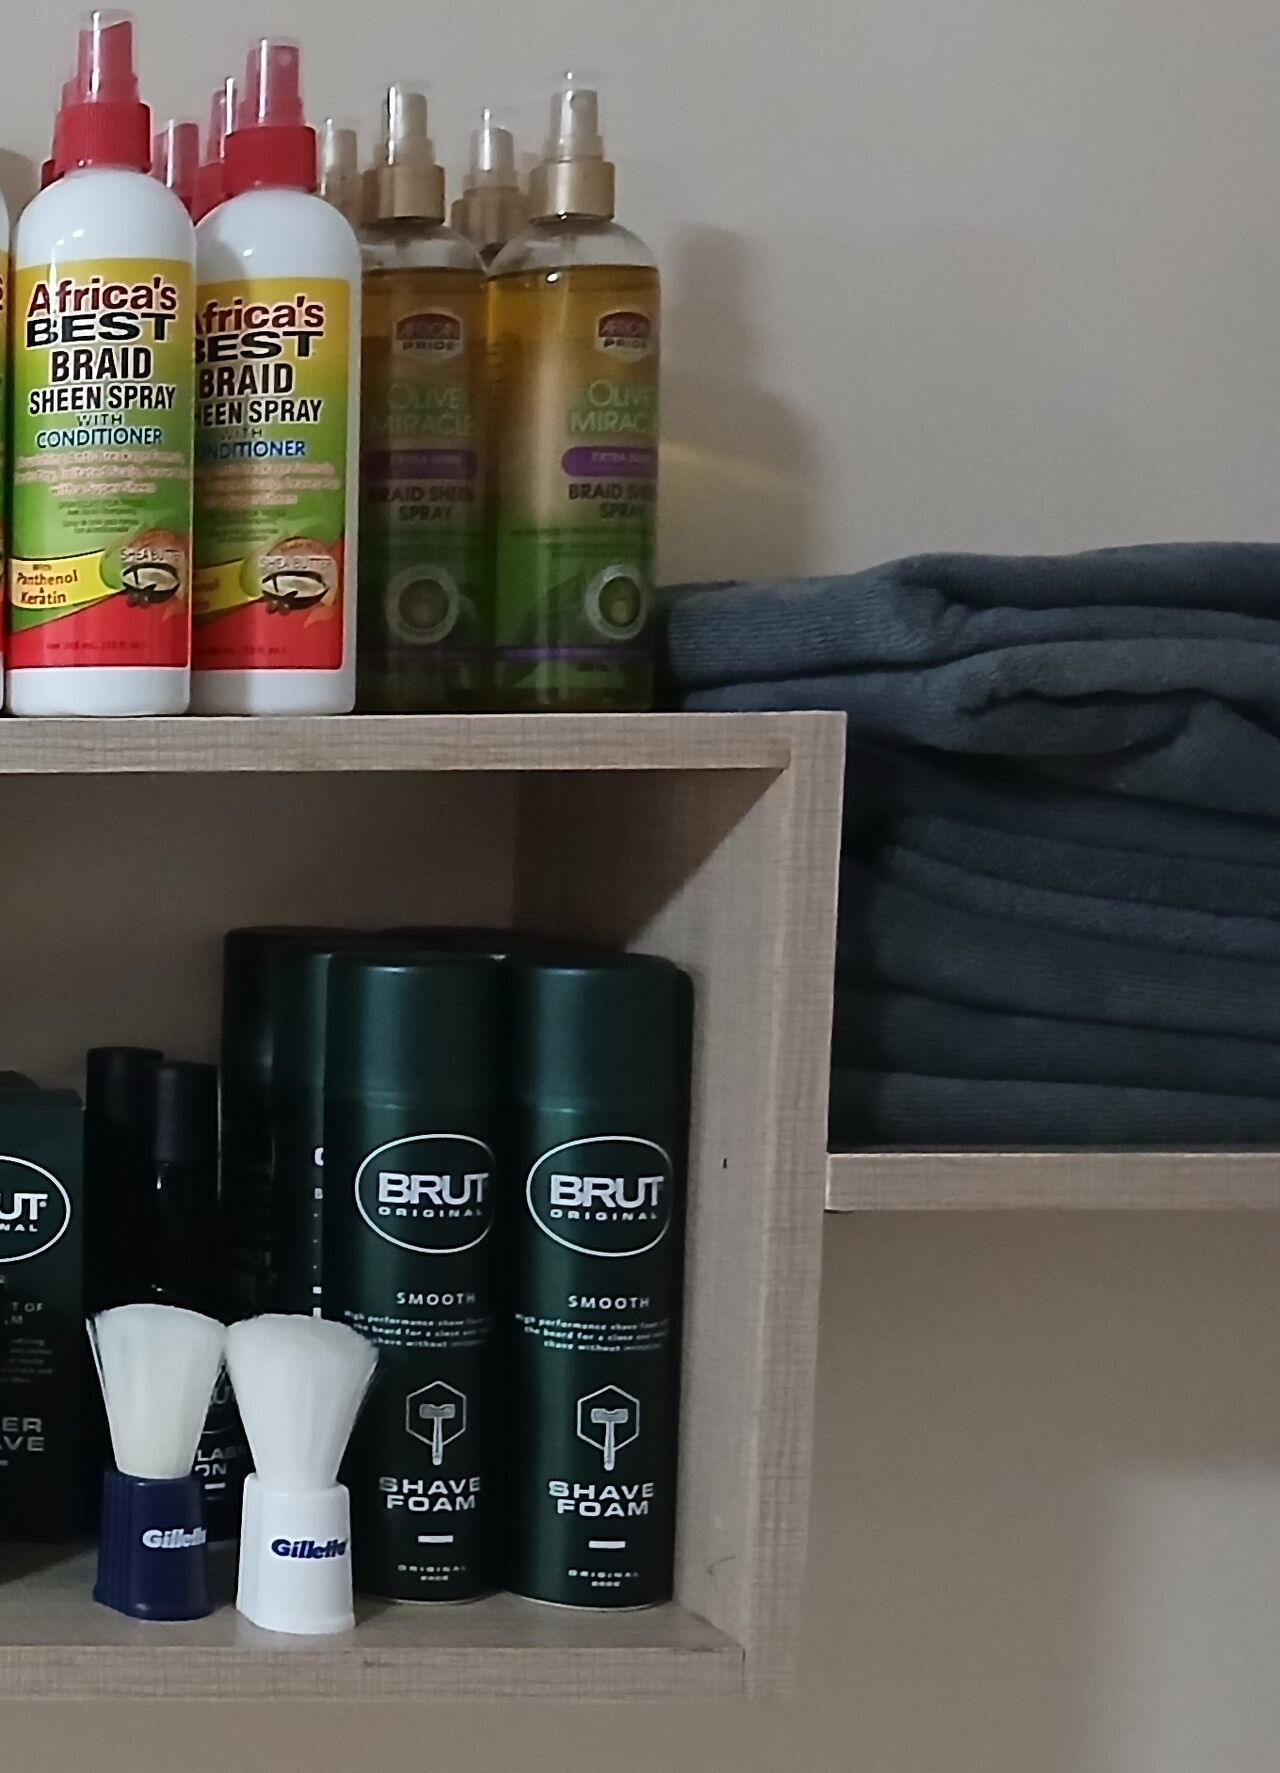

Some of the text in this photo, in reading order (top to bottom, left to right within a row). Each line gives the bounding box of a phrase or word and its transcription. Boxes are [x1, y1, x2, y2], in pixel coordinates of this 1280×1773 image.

[28, 277, 177, 317] Africa's
[27, 312, 176, 348] BEST
[52, 347, 152, 382] BRAID
[199, 364, 293, 398] BRAID
[30, 385, 176, 414] SHEEN SPRAY
[78, 413, 122, 426] WITH
[203, 400, 322, 426] EEN SPRAY
[37, 428, 162, 449] CONDITIONER
[569, 484, 623, 500] BRAID
[399, 505, 453, 521] SPRAY
[17, 570, 78, 586] Panthenol
[21, 591, 66, 605] Keratin
[379, 1172, 489, 1204] BRUT
[550, 1174, 664, 1209] BRUT
[379, 1206, 483, 1218] ORIGINAL
[550, 1208, 658, 1221] ORIGINAL
[396, 1291, 476, 1305] SMOOTH
[568, 1295, 650, 1310] SMOOTH
[543, 1328, 574, 1340] beard
[379, 1476, 481, 1495] SHAVE
[548, 1480, 654, 1500] SHAVE
[386, 1494, 476, 1512] FOAM
[556, 1499, 649, 1518] FOAM
